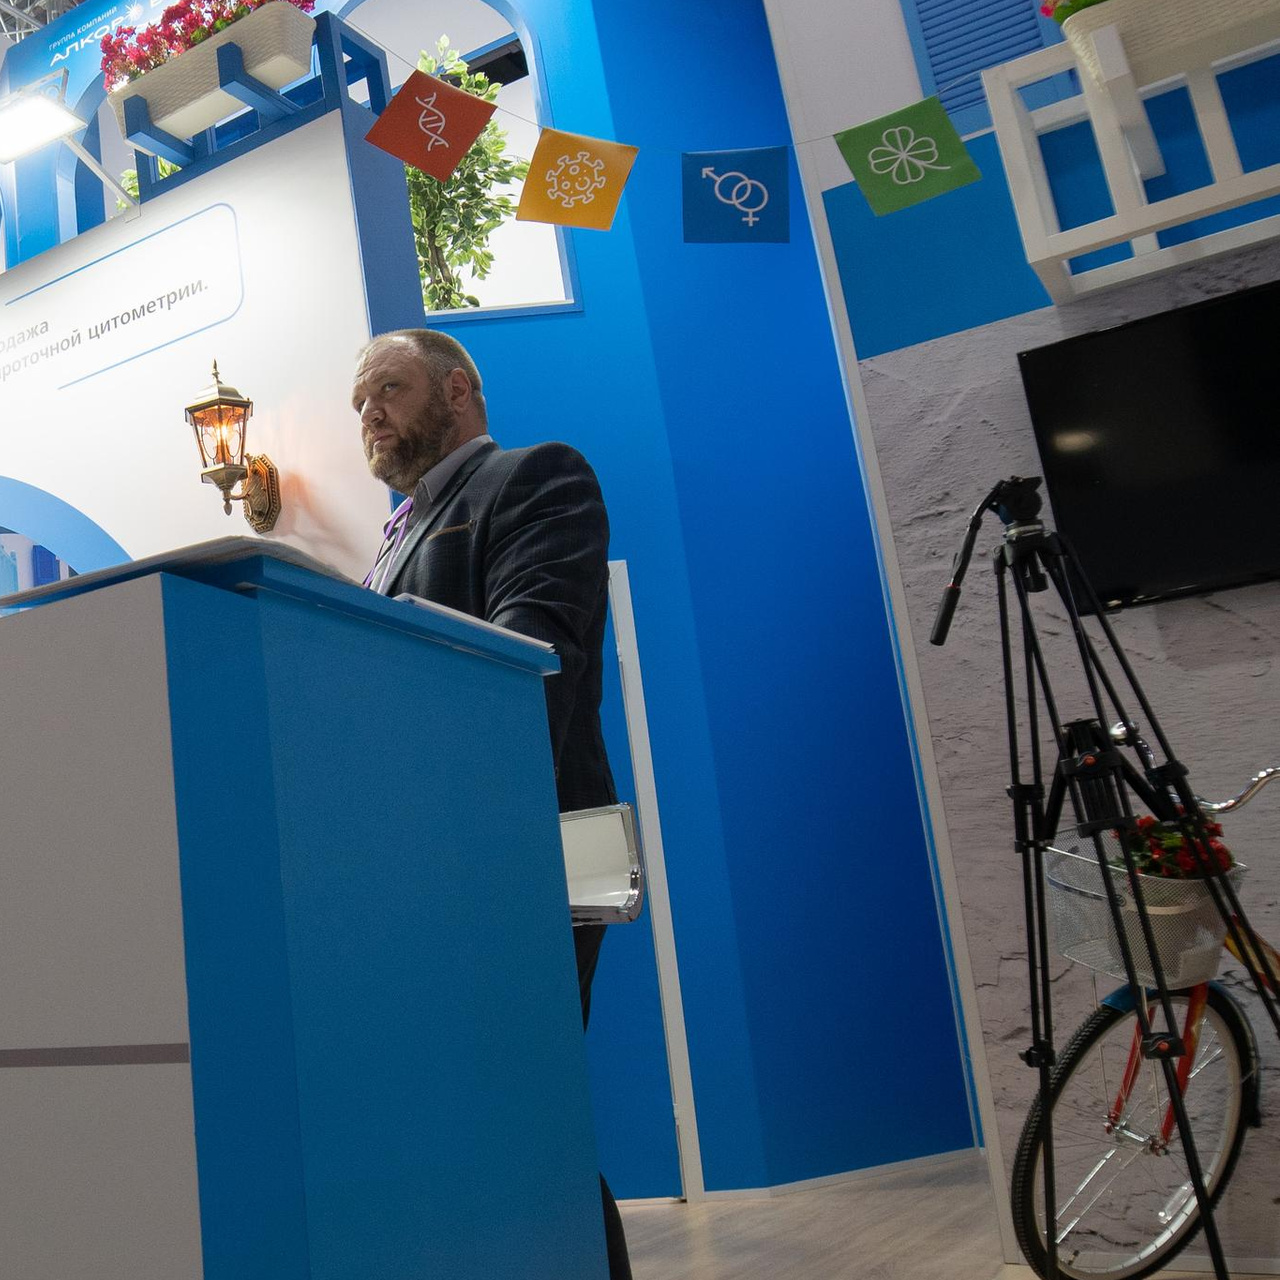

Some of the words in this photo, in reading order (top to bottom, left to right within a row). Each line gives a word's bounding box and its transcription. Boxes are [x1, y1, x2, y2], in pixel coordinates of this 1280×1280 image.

[48, 31, 77, 52] ГРУППА
[76, 5, 119, 36] КОМПАНИЙ
[50, 15, 126, 67] АЛКОР
[87, 278, 209, 342] цитометрии.
